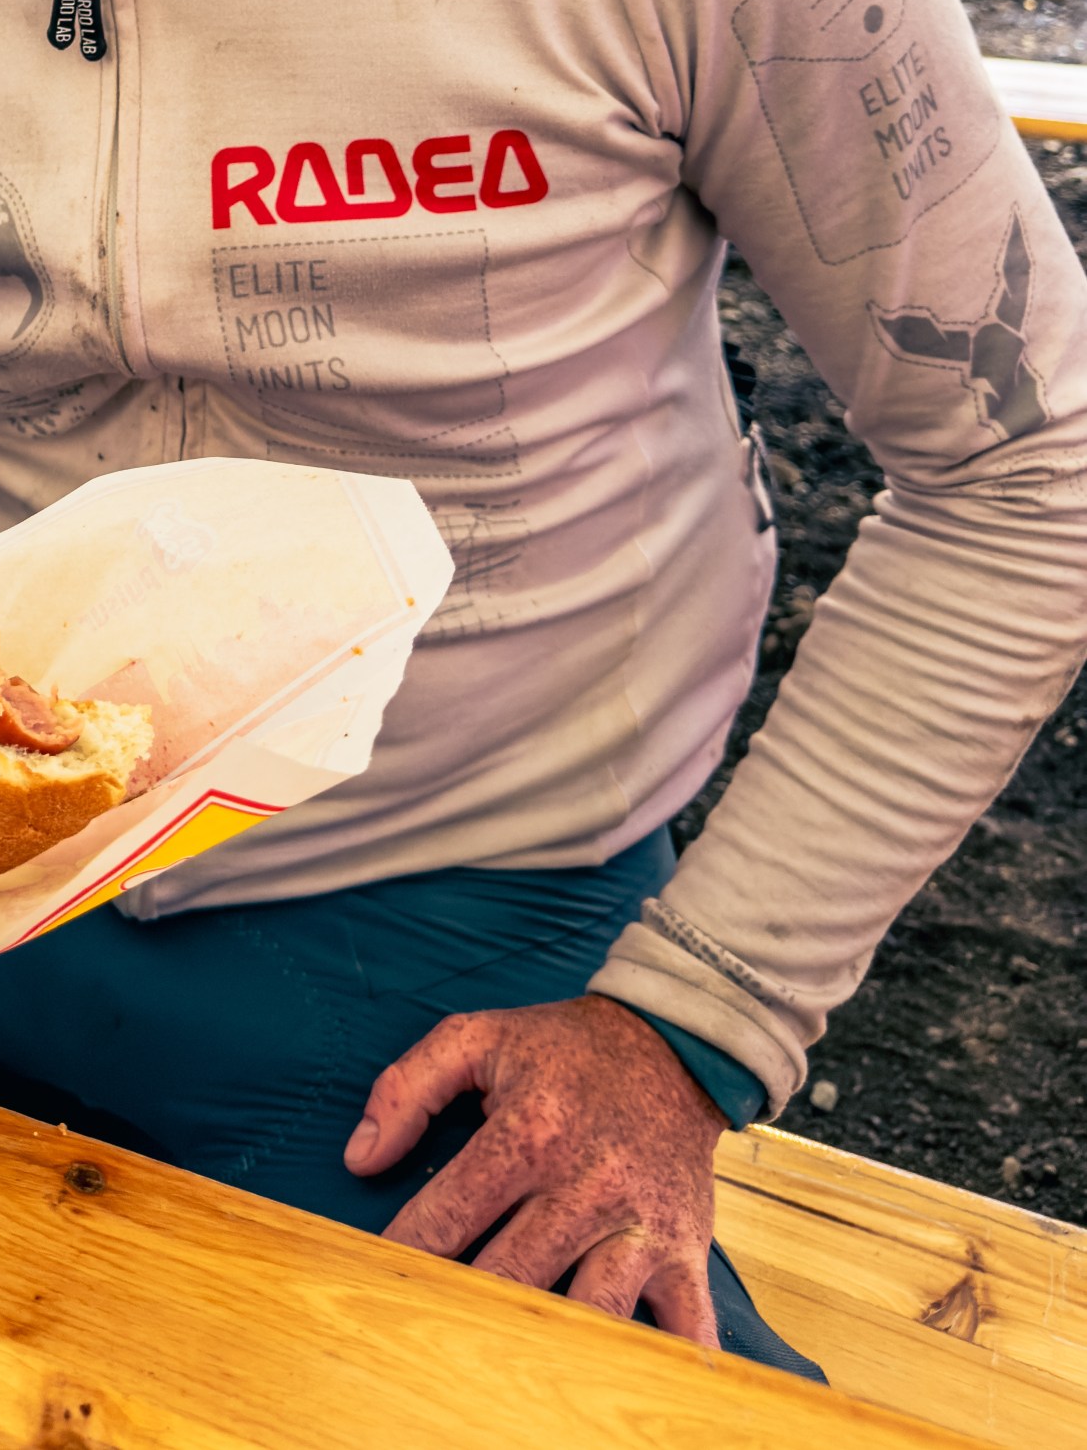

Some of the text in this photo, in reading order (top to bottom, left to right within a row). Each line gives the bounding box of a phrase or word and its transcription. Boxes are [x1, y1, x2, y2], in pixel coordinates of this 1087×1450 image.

[55, 18, 73, 43] LAB
[80, 29, 98, 55] LAB
[858, 41, 926, 116] ELITE
[874, 83, 938, 160] MOON
[892, 126, 953, 201] UNITS
[229, 258, 328, 299] ELITE
[235, 302, 337, 353] MOON
